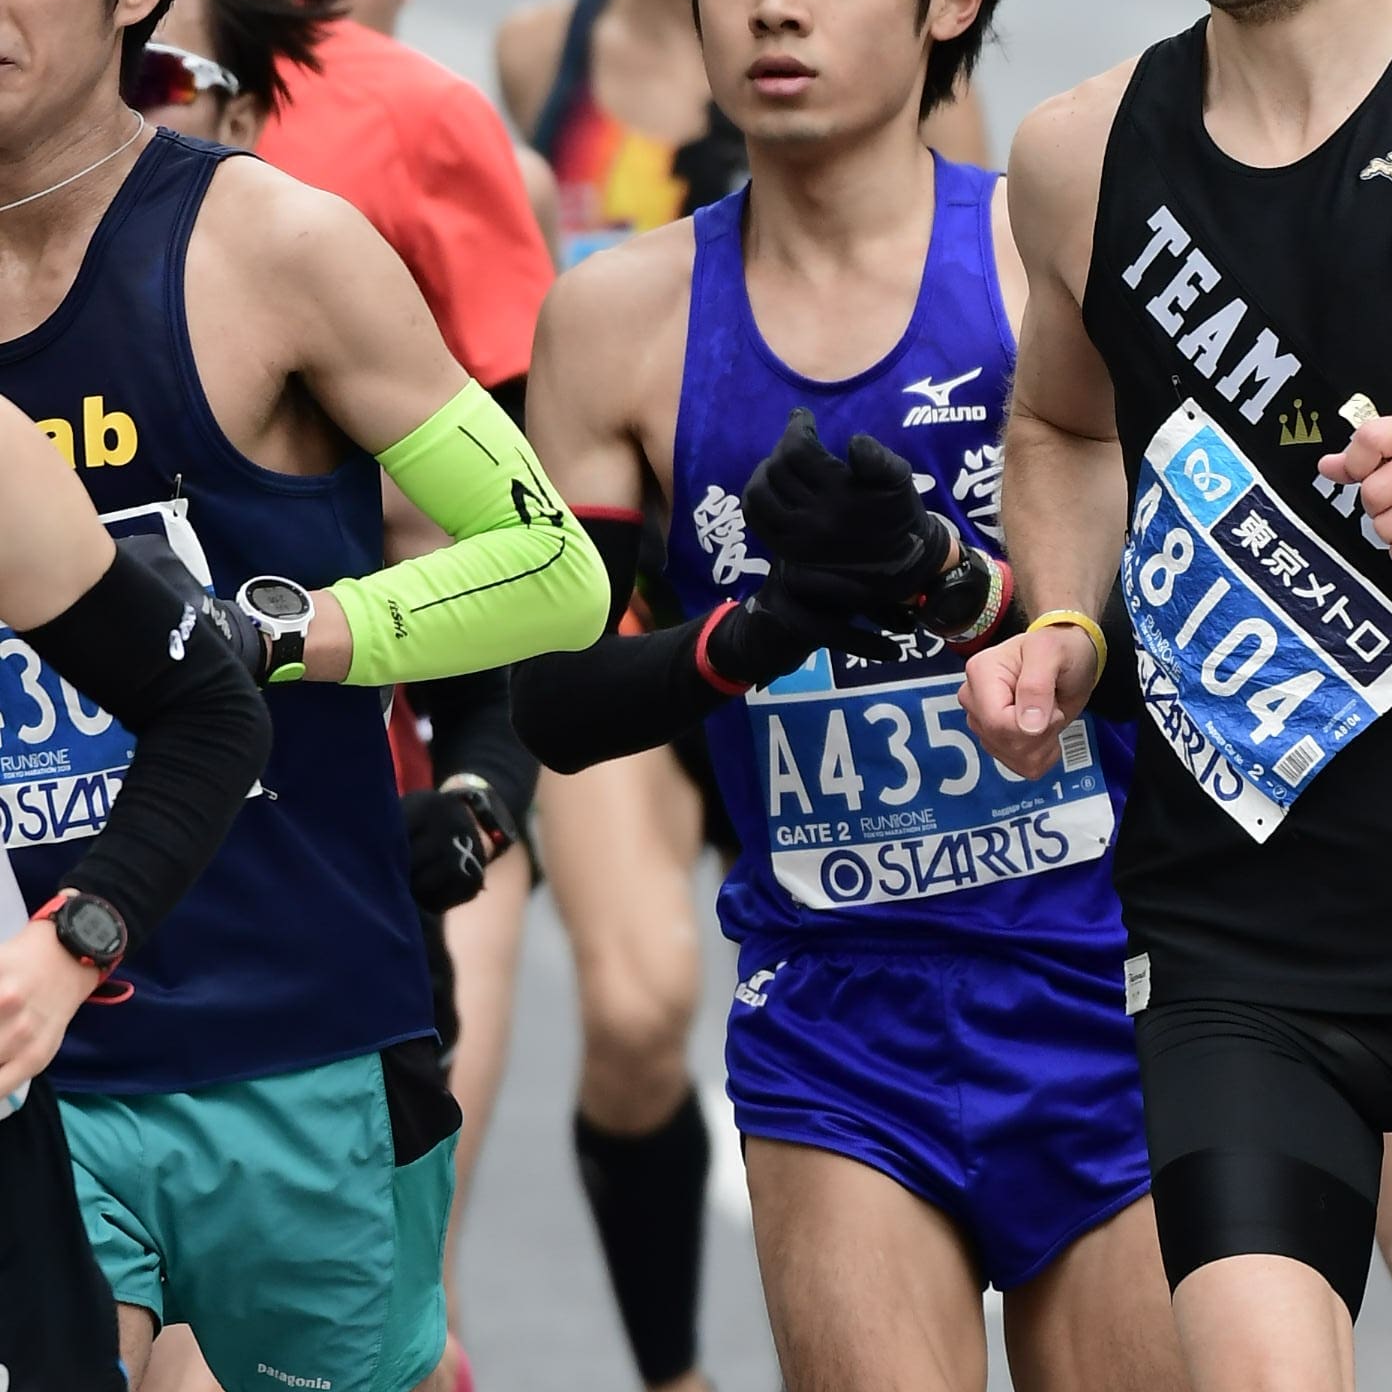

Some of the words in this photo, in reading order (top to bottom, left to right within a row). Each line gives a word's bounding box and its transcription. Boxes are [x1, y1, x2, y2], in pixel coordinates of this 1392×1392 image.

[1122, 205, 1301, 426] TEAM
[902, 406, 988, 428] MIZUNO
[1230, 509, 1391, 664] 東京メトロ
[768, 693, 1027, 817] A435
[17, 770, 128, 841] STA
[776, 823, 834, 846] GATE
[838, 821, 852, 841] 2
[876, 811, 1071, 896] STARTS
[257, 1363, 331, 1391] patagonia
